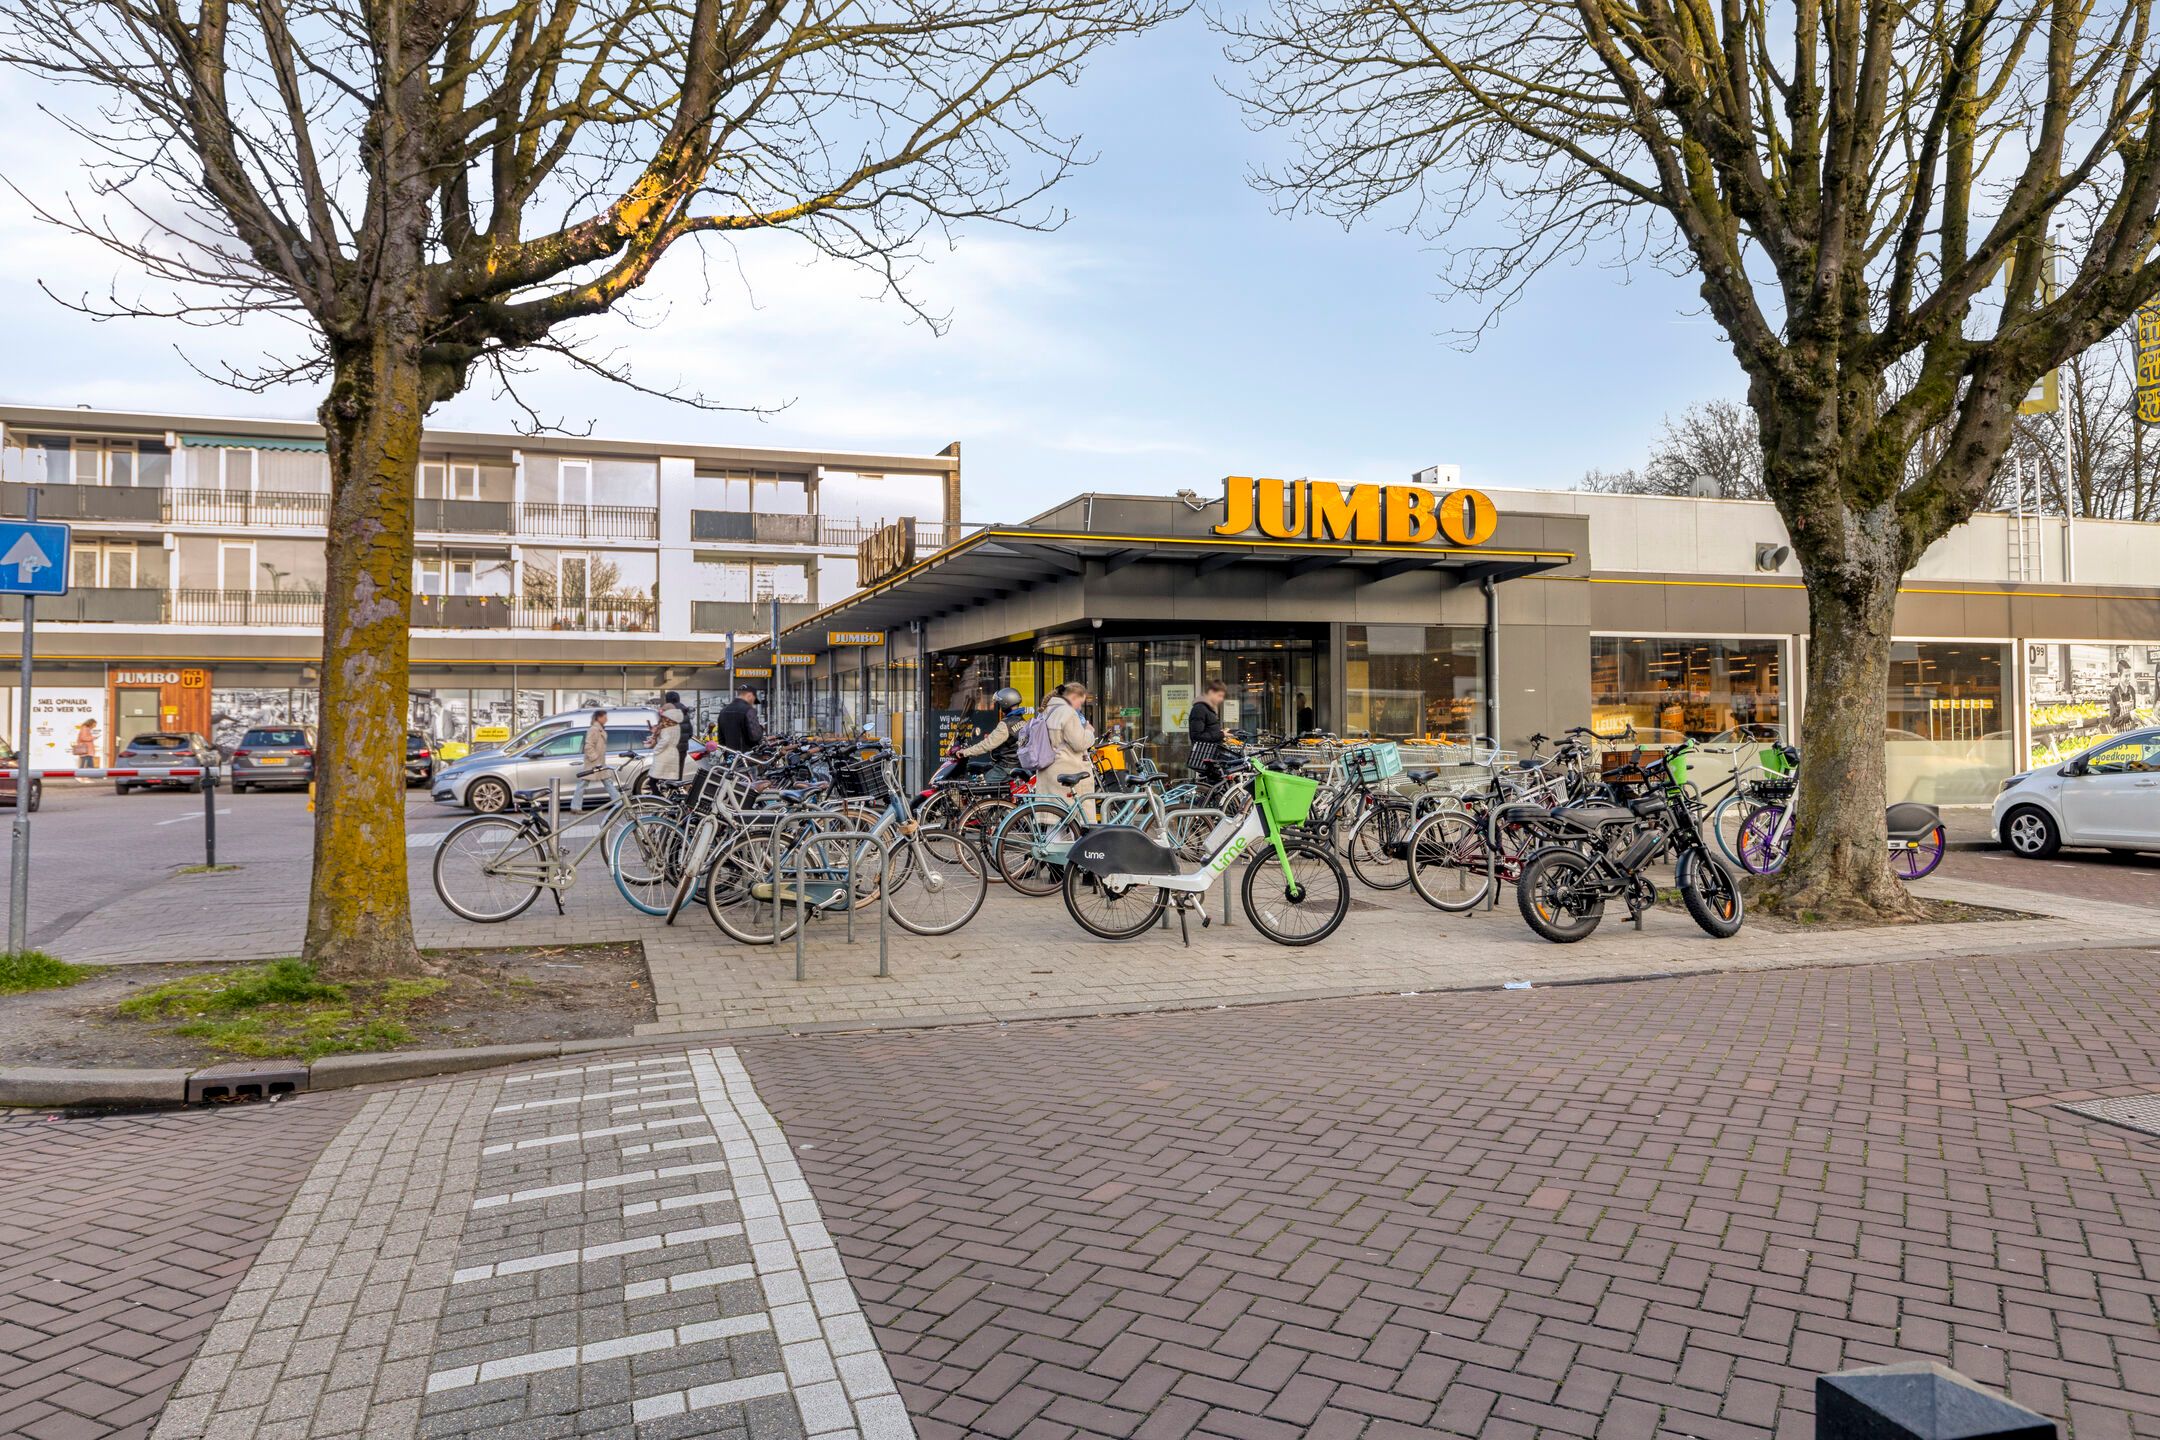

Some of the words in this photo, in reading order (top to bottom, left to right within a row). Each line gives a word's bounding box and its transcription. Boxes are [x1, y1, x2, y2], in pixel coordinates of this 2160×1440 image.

[1211, 476, 1498, 547] JUMBO
[857, 516, 914, 588] JUMBO
[835, 634, 879, 644] JUMBO
[778, 655, 811, 663] UMBO
[115, 672, 179, 684] JUMBO
[184, 677, 202, 686] UP
[940, 715, 951, 723] Wij
[1085, 850, 1105, 860] Lime
[1211, 836, 1248, 872] Lime
